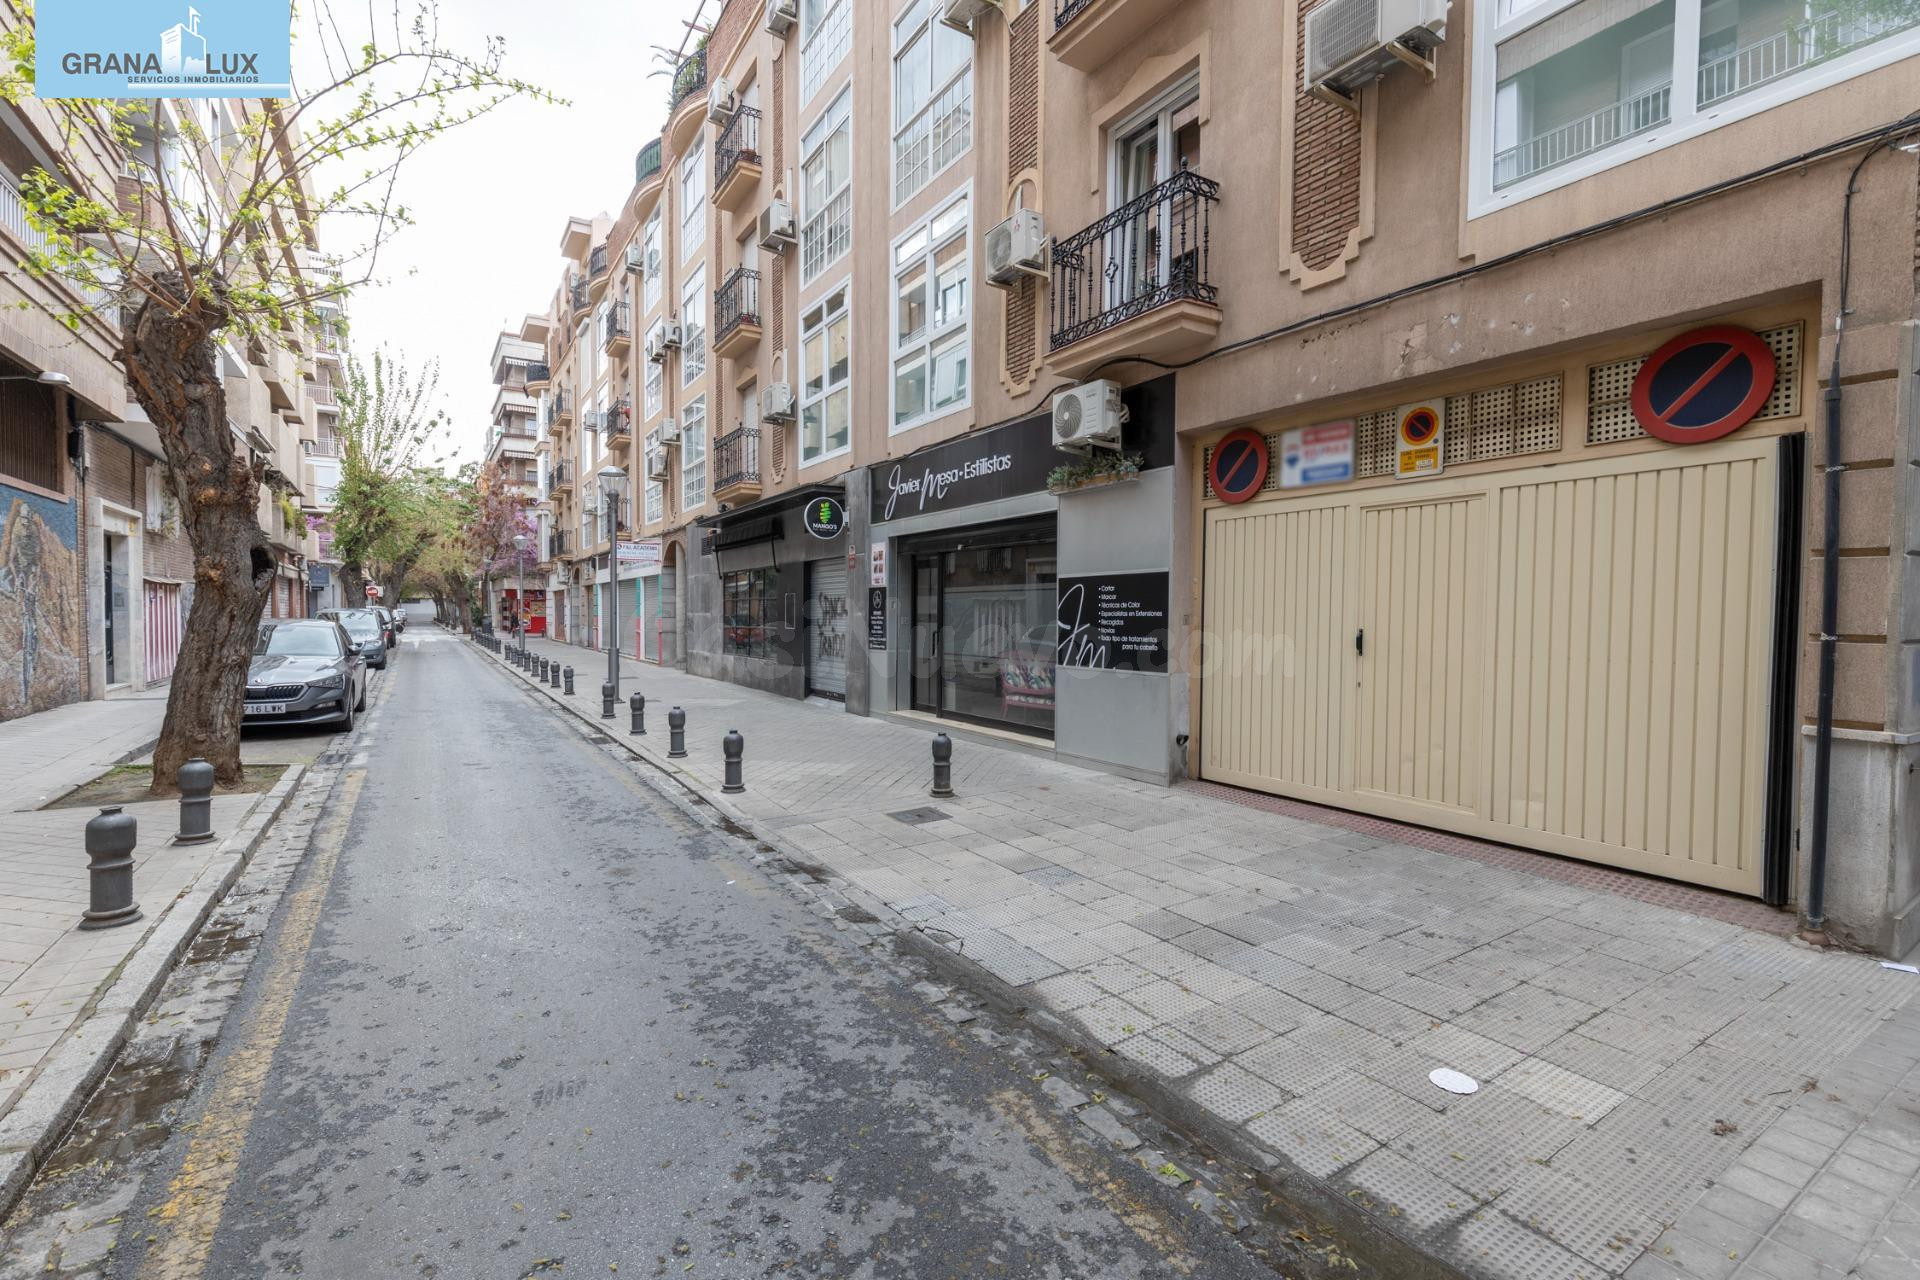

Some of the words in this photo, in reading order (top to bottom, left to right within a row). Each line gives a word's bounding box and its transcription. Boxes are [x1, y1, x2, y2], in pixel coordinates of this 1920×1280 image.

[884, 464, 921, 521] Javier
[919, 468, 959, 511] Mesa
[963, 453, 1012, 480] Estilistas
